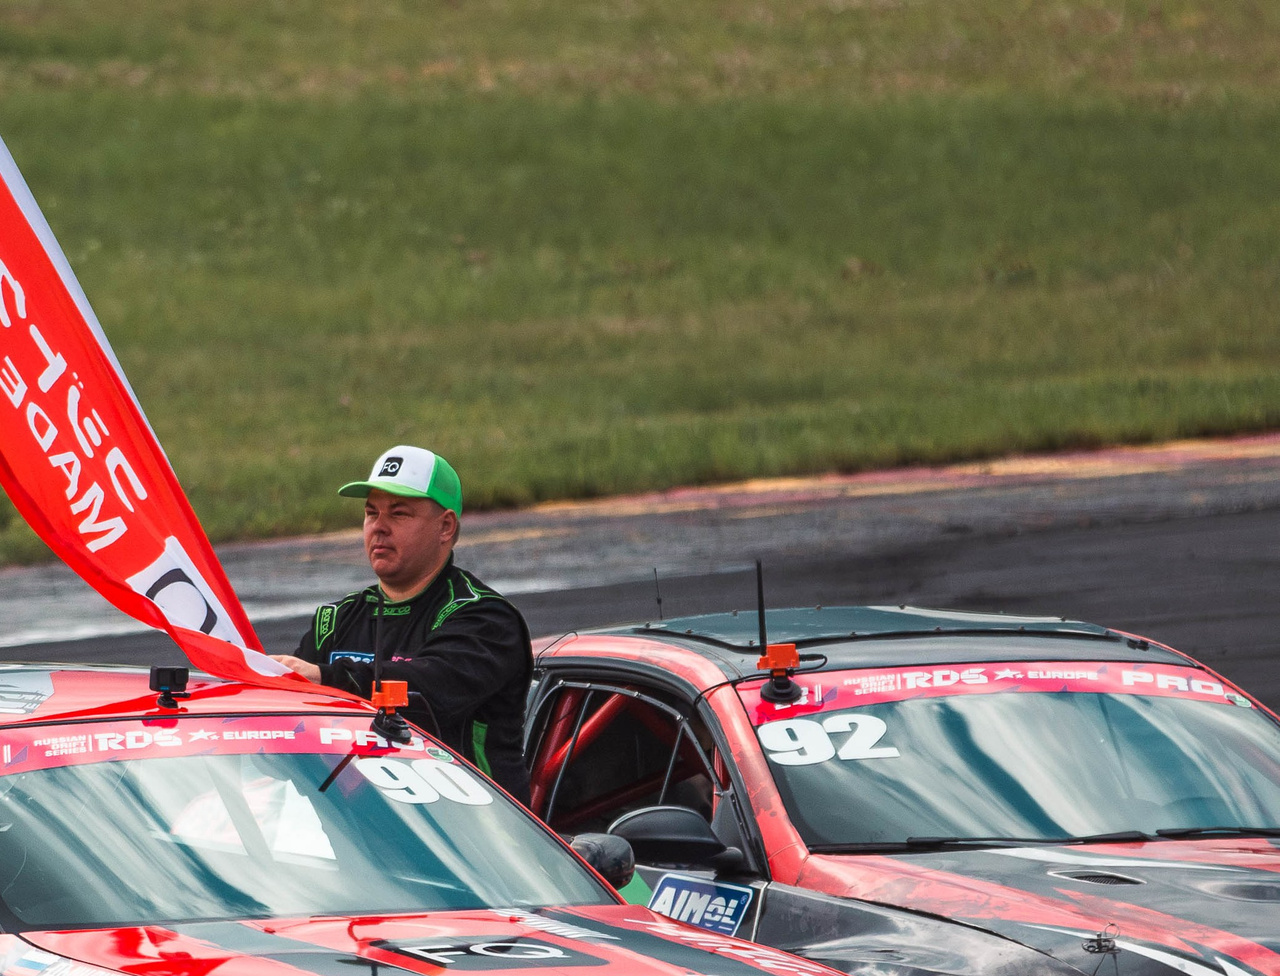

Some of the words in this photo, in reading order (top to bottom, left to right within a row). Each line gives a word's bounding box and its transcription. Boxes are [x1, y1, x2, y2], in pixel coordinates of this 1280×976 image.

[381, 461, 400, 473] FQ
[843, 674, 895, 685] RUSSIAN
[861, 680, 895, 690] DRIFT
[903, 668, 989, 689] RDS
[1027, 670, 1098, 681] EUROPE
[1122, 670, 1225, 696] PRO
[854, 686, 895, 696] SERIES
[33, 734, 87, 746] RUSSIAN
[51, 741, 86, 750] DRIFT
[94, 728, 183, 752] RDS
[223, 730, 296, 740] EUROPE
[758, 713, 901, 766] 92
[45, 747, 87, 757] SERIES
[355, 758, 494, 806] 90
[651, 886, 738, 930] AIMOL
[400, 942, 571, 964] FQ
